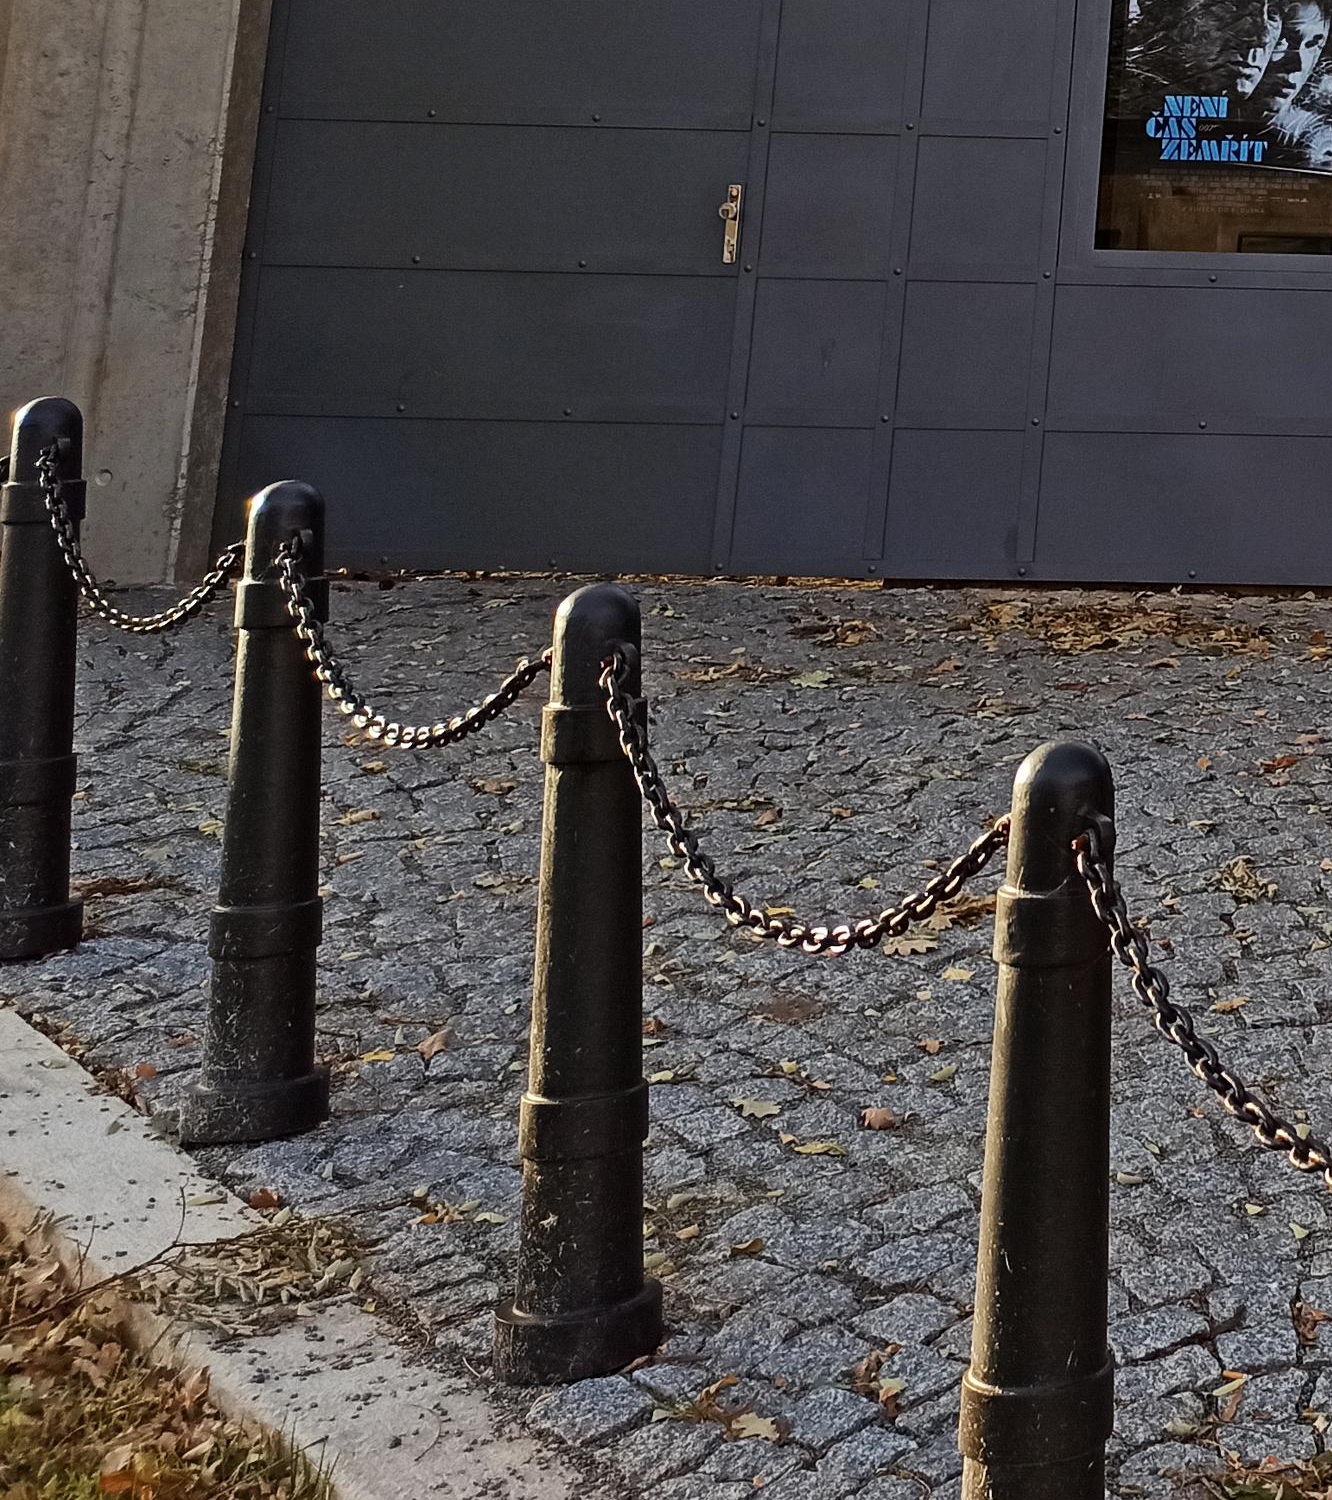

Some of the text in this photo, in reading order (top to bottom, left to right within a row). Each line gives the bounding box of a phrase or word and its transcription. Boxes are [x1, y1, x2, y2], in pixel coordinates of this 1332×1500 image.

[1163, 90, 1229, 118] NENÍ
[1145, 111, 1197, 138] ČAS
[1160, 134, 1268, 162] ZEMŘÍT
